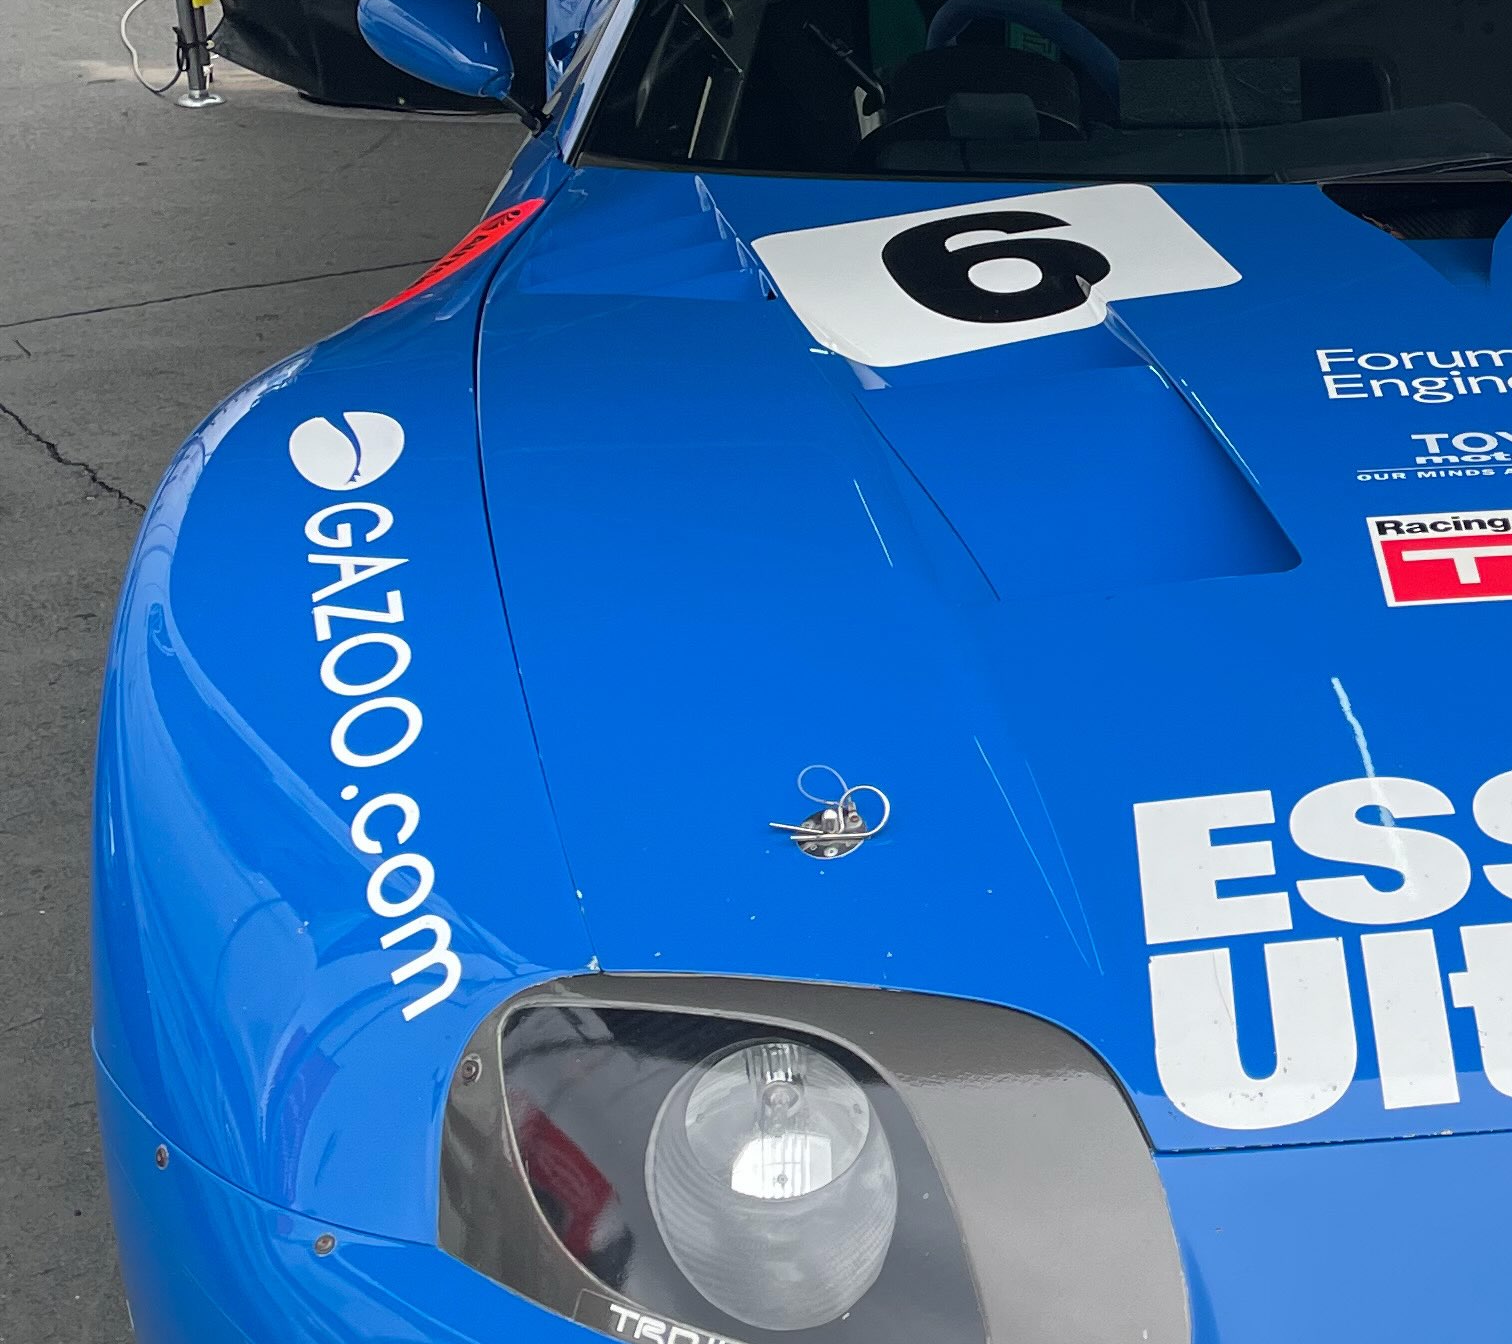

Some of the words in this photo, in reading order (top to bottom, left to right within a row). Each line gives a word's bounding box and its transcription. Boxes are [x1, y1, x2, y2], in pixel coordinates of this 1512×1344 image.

[882, 210, 1112, 323] 6
[1356, 472, 1407, 482] OUR
[1417, 468, 1495, 479] MINDS
[1375, 516, 1512, 537] Racing
[304, 501, 462, 1023] GAZOO.com
